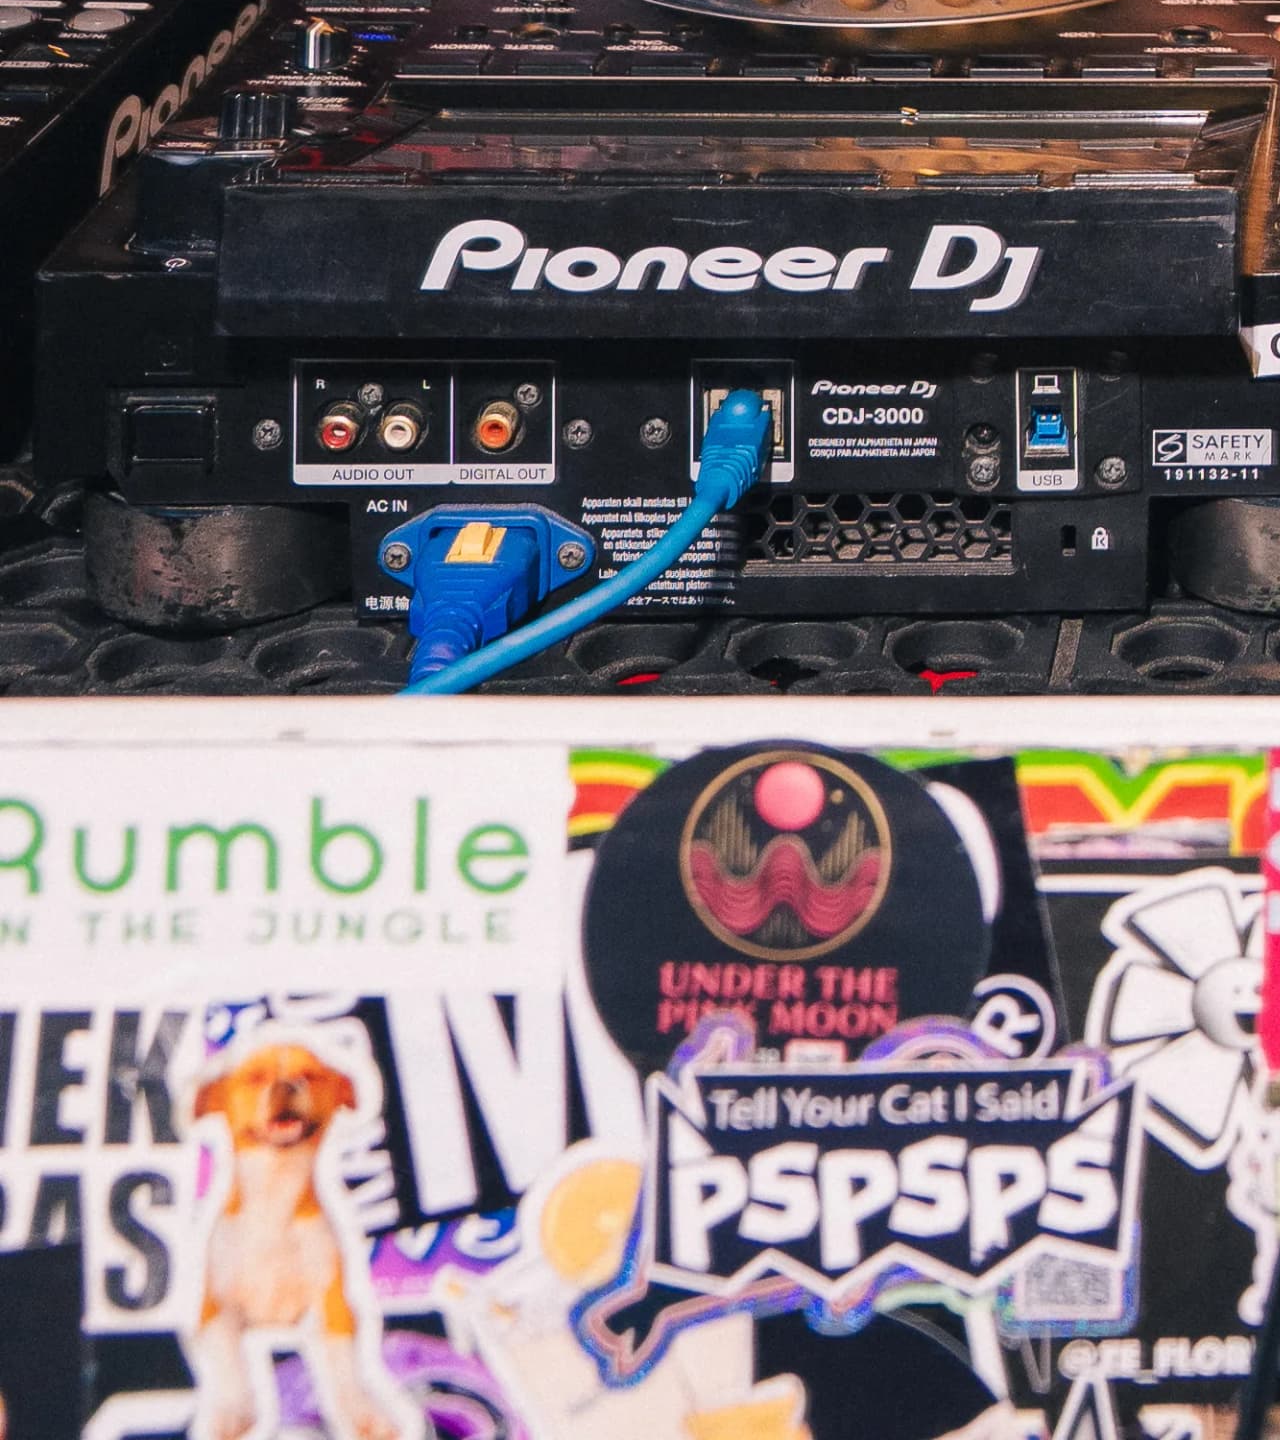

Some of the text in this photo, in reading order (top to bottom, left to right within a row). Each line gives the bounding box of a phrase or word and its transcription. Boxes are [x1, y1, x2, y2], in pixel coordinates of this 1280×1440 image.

[420, 219, 888, 293] Pioneer
[315, 379, 327, 390] R
[422, 378, 431, 390] L
[811, 380, 906, 395] Pioneer
[822, 407, 925, 425] CDJ-3000
[808, 437, 846, 447] DESIGNED
[846, 437, 857, 447] BY
[857, 437, 903, 447] ALPHATHETA
[913, 437, 938, 447] JAPAN
[1191, 431, 1267, 453] SAFETY
[836, 447, 852, 457] PAR
[852, 447, 899, 457] ALPHATHETA
[899, 447, 910, 457] AU
[910, 447, 936, 457] JAPON
[1205, 450, 1254, 462] MARK
[331, 466, 416, 482] AUDIO OUT
[458, 465, 549, 482] DIGITAL OUT
[1031, 473, 1063, 487] USB
[1163, 468, 1261, 481] 191132-11
[366, 498, 409, 513] AC IN
[64, 909, 518, 947] THE JUNGLE
[658, 960, 899, 1002] UNDER THE
[768, 1000, 900, 1038] MOON
[707, 1077, 1061, 1132] Tell Your Cat I Said
[668, 1133, 1120, 1272] PSPSPS
